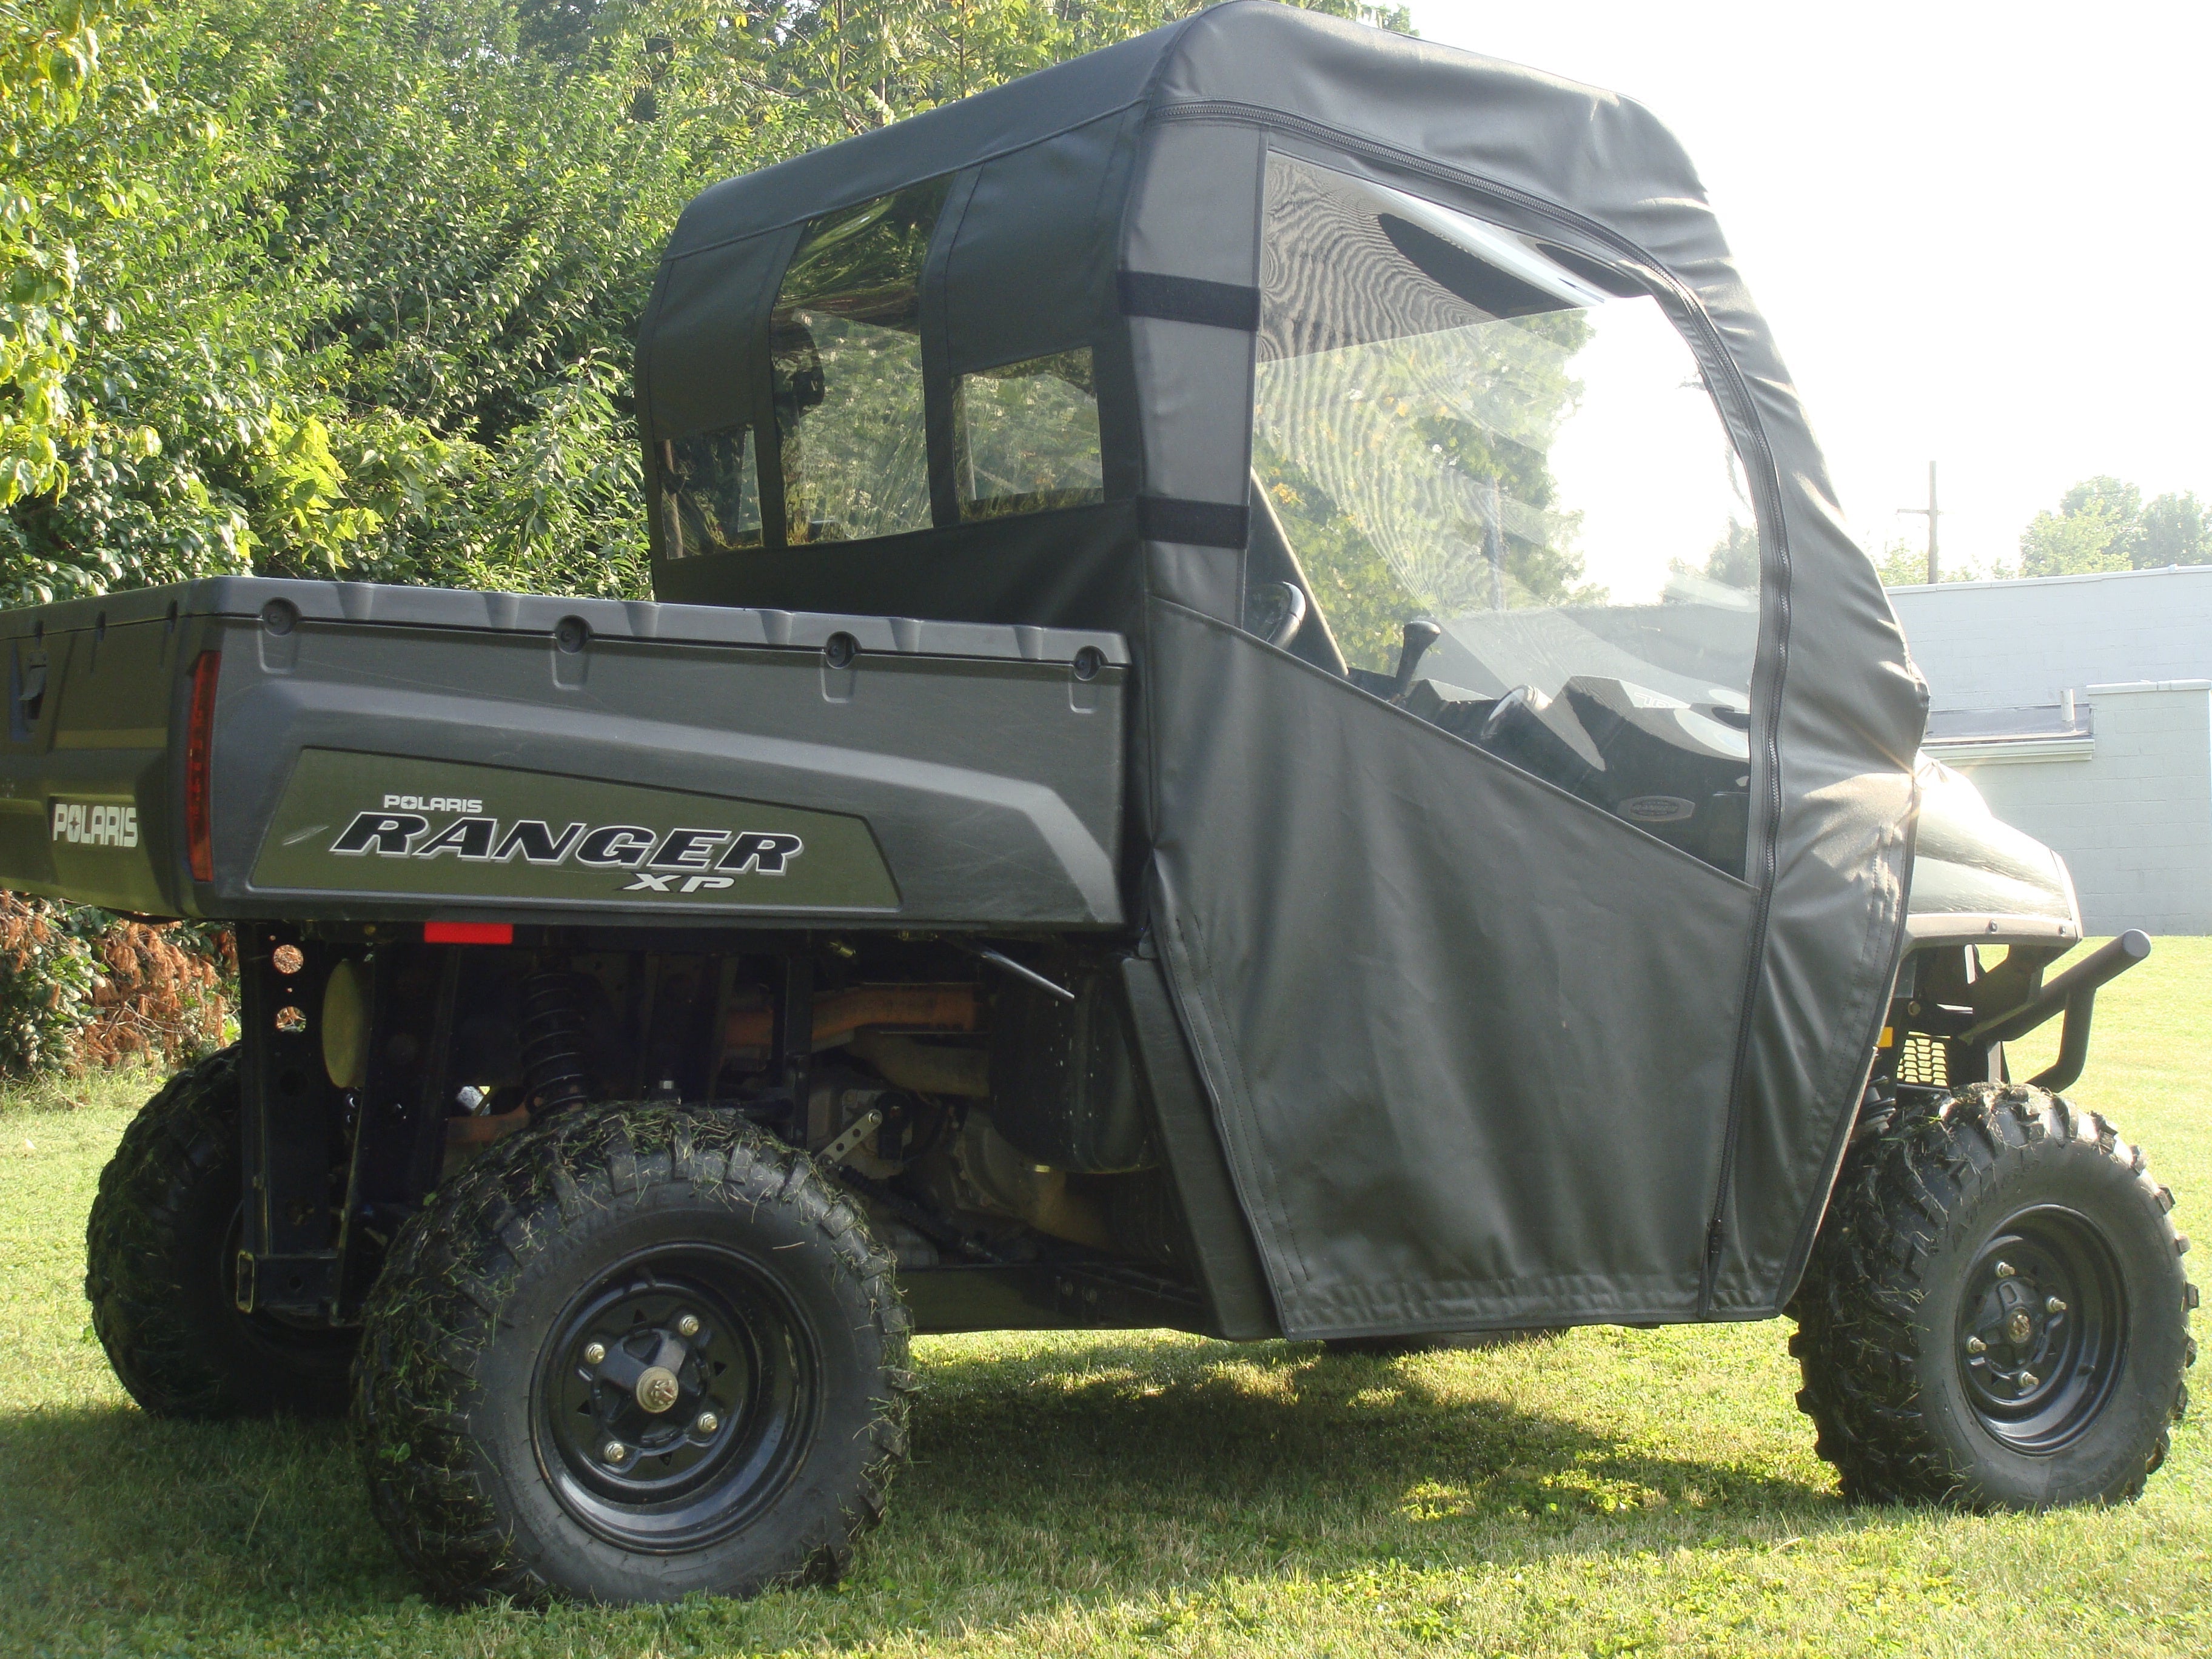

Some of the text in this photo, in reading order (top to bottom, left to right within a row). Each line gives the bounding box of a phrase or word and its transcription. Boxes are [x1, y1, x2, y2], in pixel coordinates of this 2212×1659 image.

[383, 794, 483, 813] POLARIS
[52, 803, 139, 848] POLARIS
[329, 811, 805, 875] RANGER
[617, 873, 735, 893] XP
